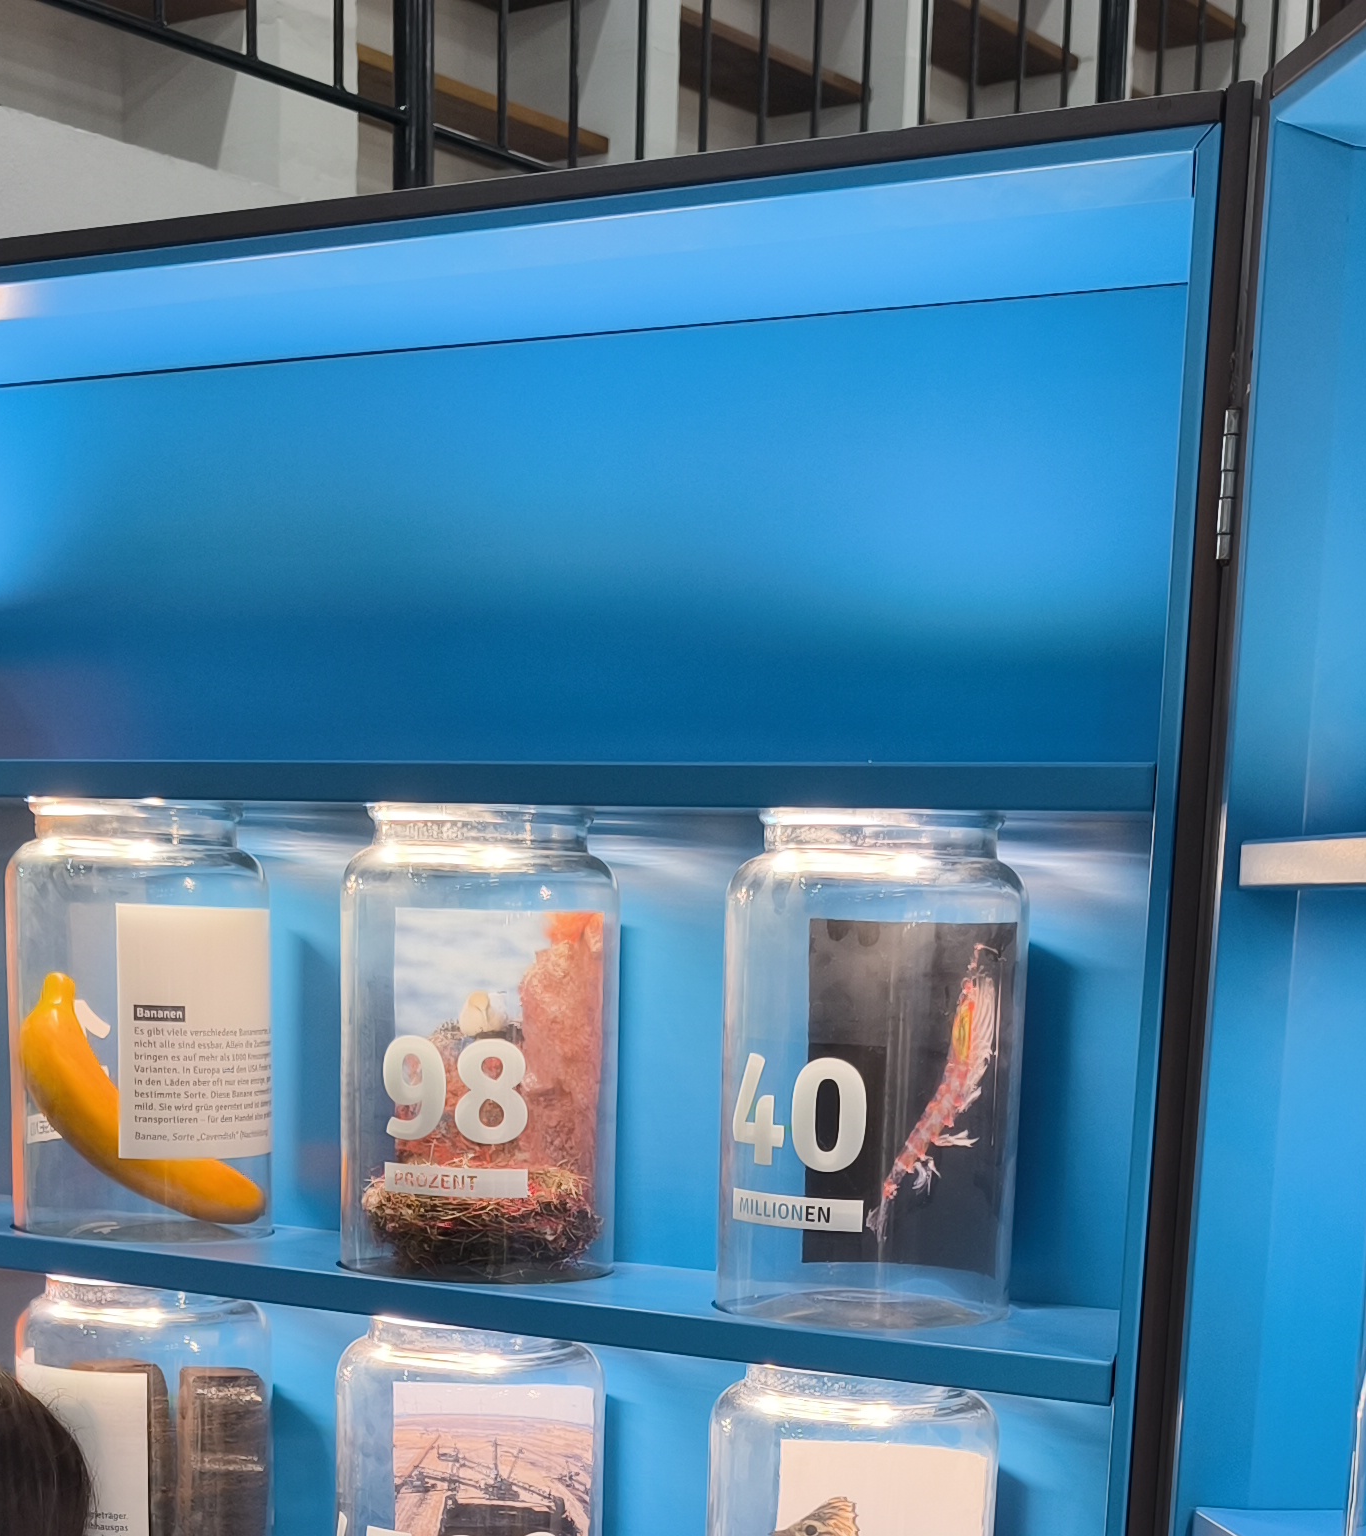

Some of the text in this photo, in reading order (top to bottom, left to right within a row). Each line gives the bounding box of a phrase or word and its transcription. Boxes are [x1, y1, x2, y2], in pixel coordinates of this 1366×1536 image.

[136, 1007, 183, 1019] Bananen
[135, 1027, 145, 1035] Es
[147, 1028, 164, 1037] gibt
[166, 1028, 187, 1036] viele
[190, 1029, 237, 1037] verschiedene
[134, 1040, 156, 1049] nicht
[159, 1040, 175, 1049] alle
[178, 1040, 195, 1049] sind
[197, 1041, 224, 1049] essbar.
[134, 1052, 168, 1062] bringen
[183, 1053, 196, 1062] auf
[198, 1054, 218, 1062] mehr
[220, 1053, 231, 1061] als
[134, 1064, 179, 1074] Varianten.
[182, 1066, 191, 1074] In
[193, 1066, 221, 1076] Europa
[145, 1078, 223, 1087] den Läden aber oft
[134, 1089, 182, 1099] bestimmte
[184, 1091, 209, 1099] Sorte.
[210, 1091, 230, 1099] Diese
[382, 1034, 528, 1145] 98
[134, 1102, 156, 1111] mild.
[159, 1103, 172, 1111] Sie
[174, 1103, 193, 1111] wird
[195, 1103, 214, 1113] grün
[732, 1052, 867, 1173] 40
[134, 1115, 199, 1125] transportieren
[207, 1115, 218, 1123] für
[220, 1115, 233, 1123] den
[135, 1132, 195, 1142] Banane, Sorte
[394, 1170, 478, 1191] PROZENT
[739, 1196, 831, 1224] MILLIONEN
